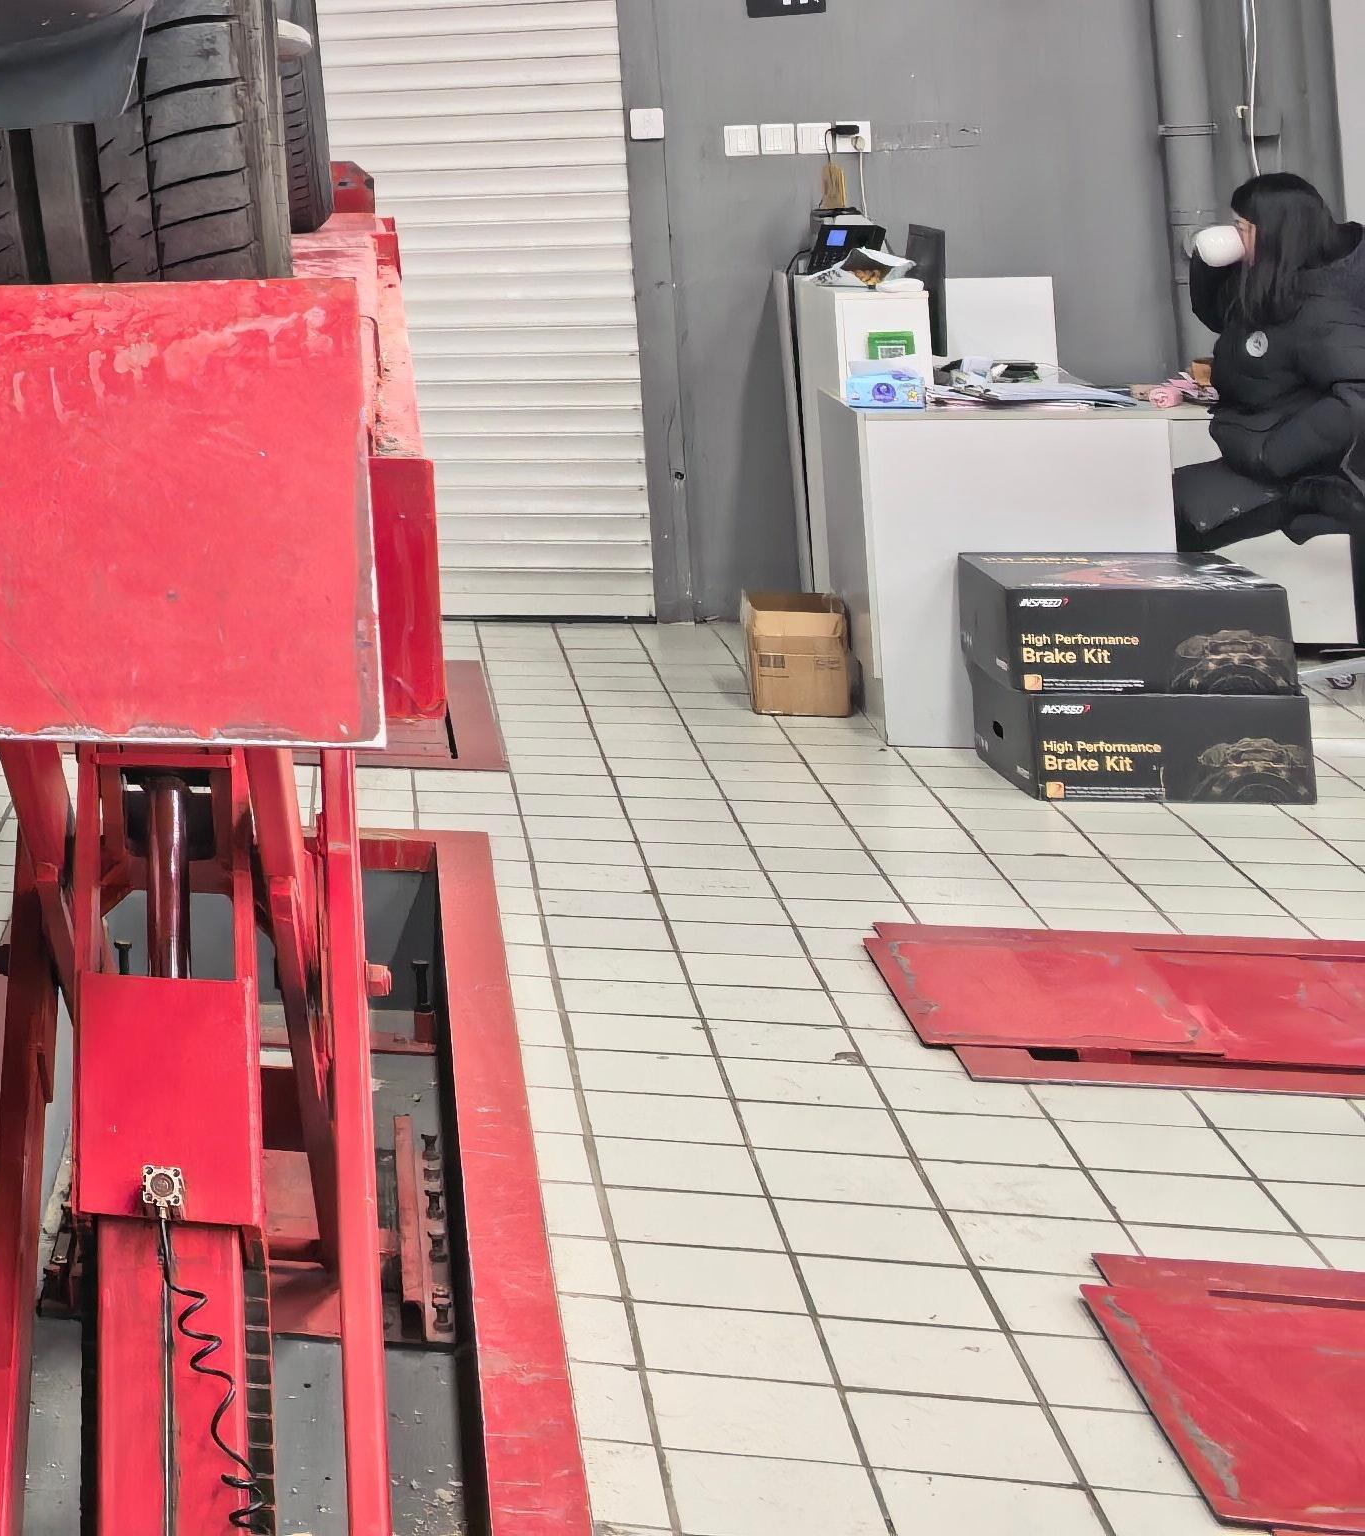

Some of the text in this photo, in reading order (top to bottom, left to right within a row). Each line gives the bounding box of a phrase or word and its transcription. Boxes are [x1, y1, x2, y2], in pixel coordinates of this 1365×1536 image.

[1021, 633, 1140, 646] High Performance
[1022, 647, 1111, 664] Brake Kit
[1042, 740, 1162, 753] High Performance
[1044, 755, 1133, 772] Brake Kit
